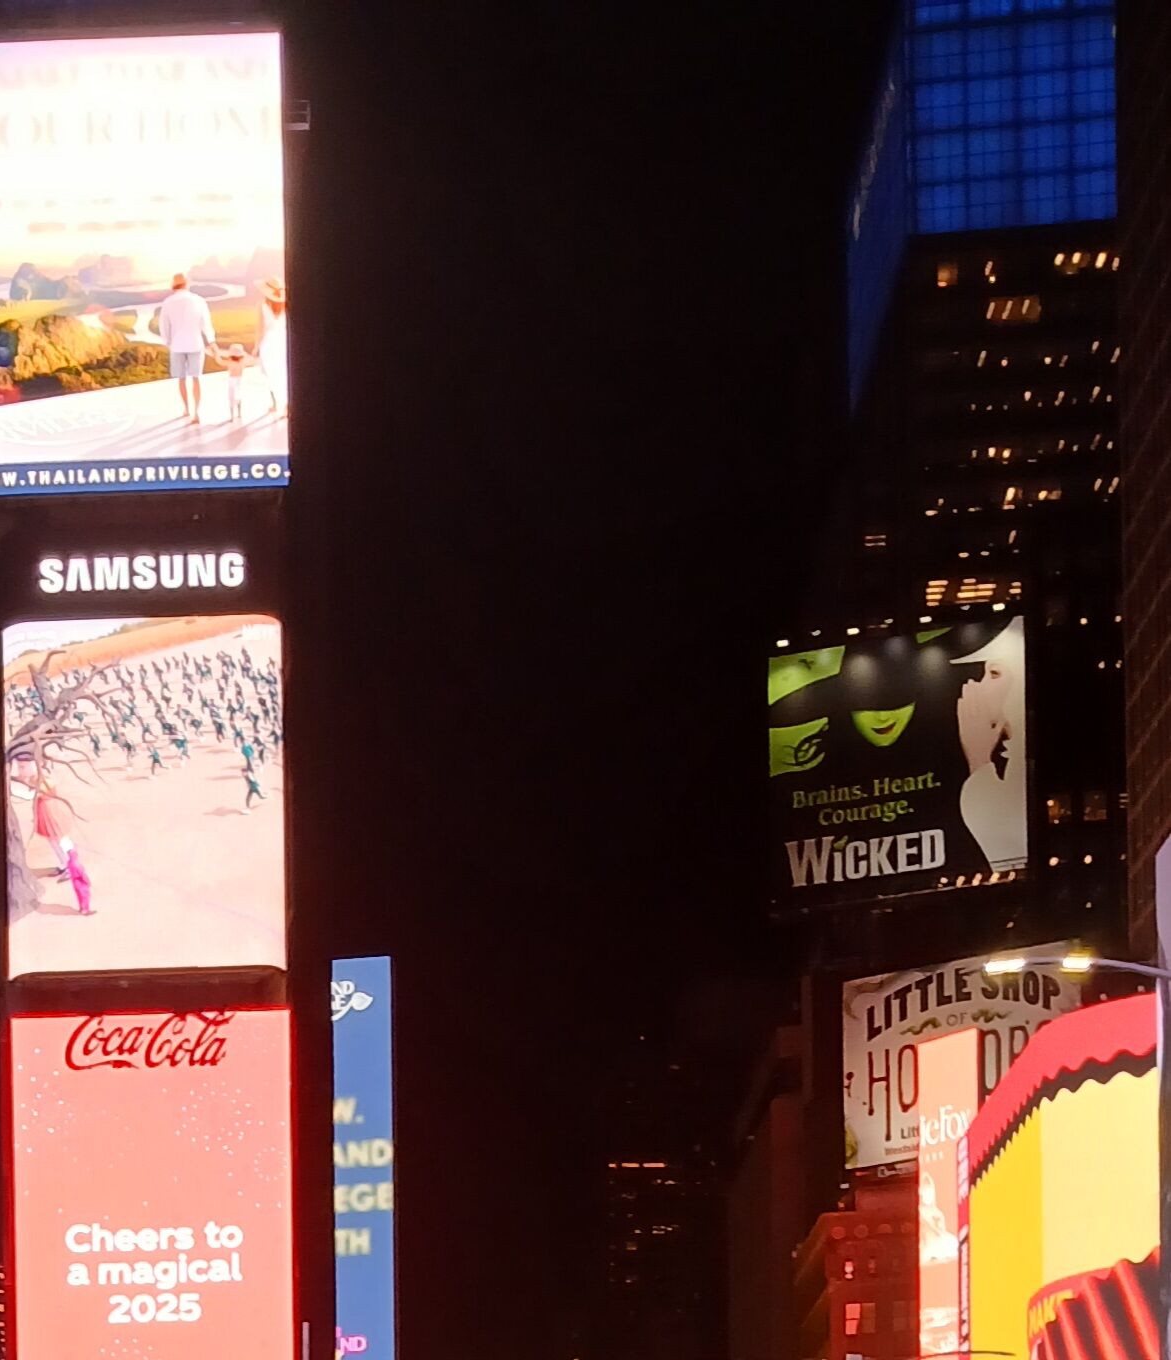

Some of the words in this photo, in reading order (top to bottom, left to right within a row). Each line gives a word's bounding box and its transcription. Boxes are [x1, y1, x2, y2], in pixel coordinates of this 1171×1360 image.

[39, 551, 245, 593] SAMSUNG
[792, 784, 868, 809] Brains.
[873, 772, 941, 797] Heart.
[818, 799, 915, 825] Courage.
[866, 967, 972, 1042] LITTLE
[981, 970, 1061, 1010] SHOP
[946, 1012, 967, 1027] OF
[65, 1011, 232, 1071] Coca-Cola
[64, 1222, 196, 1253] Cheers
[204, 1220, 244, 1249] to
[66, 1262, 90, 1286] a
[97, 1252, 243, 1290] magical
[107, 1292, 202, 1324] 2025
